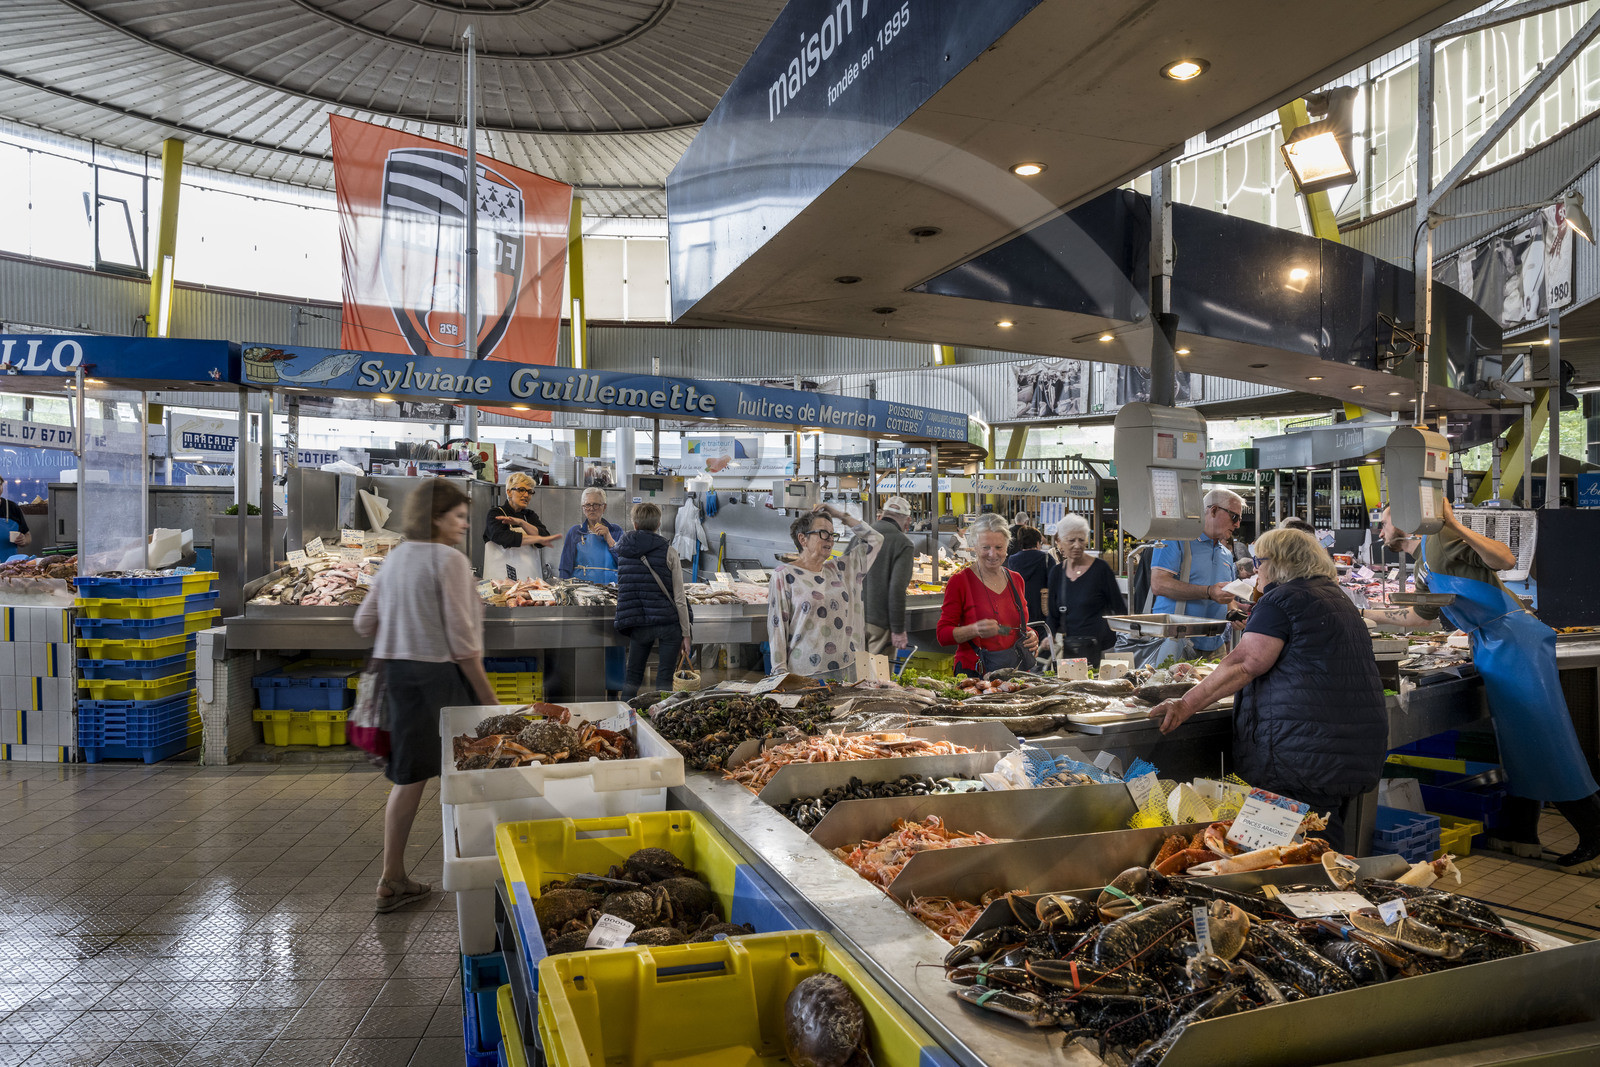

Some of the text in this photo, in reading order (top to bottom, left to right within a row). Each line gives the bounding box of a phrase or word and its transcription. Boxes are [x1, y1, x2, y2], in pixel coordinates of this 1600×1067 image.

[769, 0, 852, 122] maison
[828, 0, 910, 106] fondée en 1895
[1551, 282, 1569, 304] 1980
[1, 339, 84, 372] LLO
[358, 360, 876, 428] Sylviane Guillemette huitres de Merrien
[888, 404, 924, 421] POISSONS
[23, 426, 36, 440] 07
[41, 429, 56, 442] 67
[59, 431, 73, 444] 07
[886, 417, 919, 434] COTIERS
[35, 450, 74, 468] Moulin
[1240, 471, 1273, 482] BEOU
[1243, 818, 1288, 838] PINCES ARAIGNES
